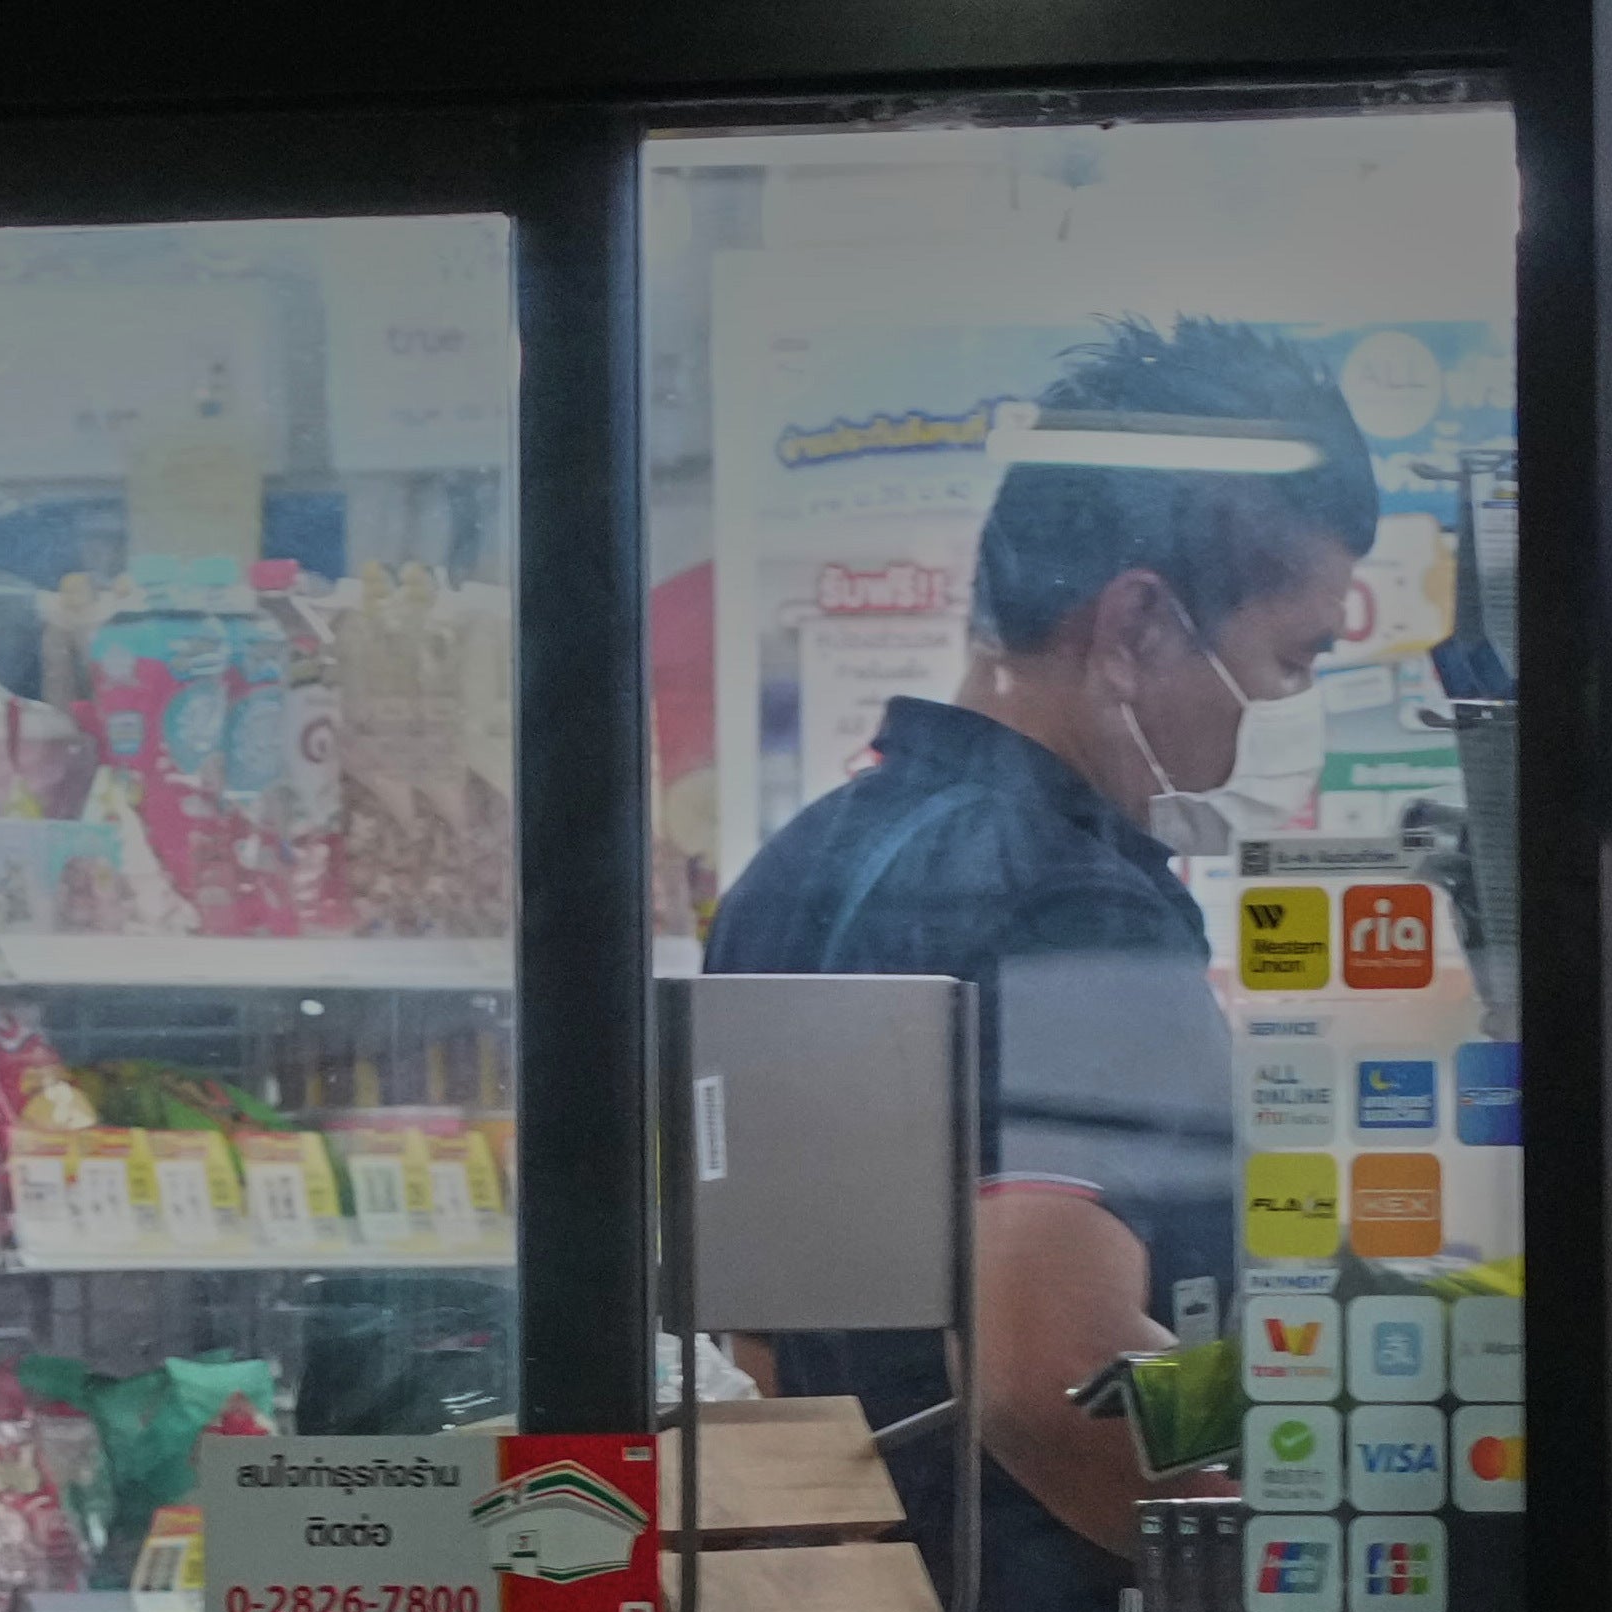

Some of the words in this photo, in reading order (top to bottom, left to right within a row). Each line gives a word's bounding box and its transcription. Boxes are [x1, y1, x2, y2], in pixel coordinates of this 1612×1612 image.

[1350, 899, 1427, 952] ria
[1252, 939, 1325, 954] Western
[1250, 958, 1304, 973] Union
[1249, 1021, 1317, 1036] SERVICE
[1357, 1442, 1438, 1473] VISA
[237, 1453, 460, 1496] สนใจทำธุรกิจร้าน
[306, 1513, 391, 1548] ติดต่อ
